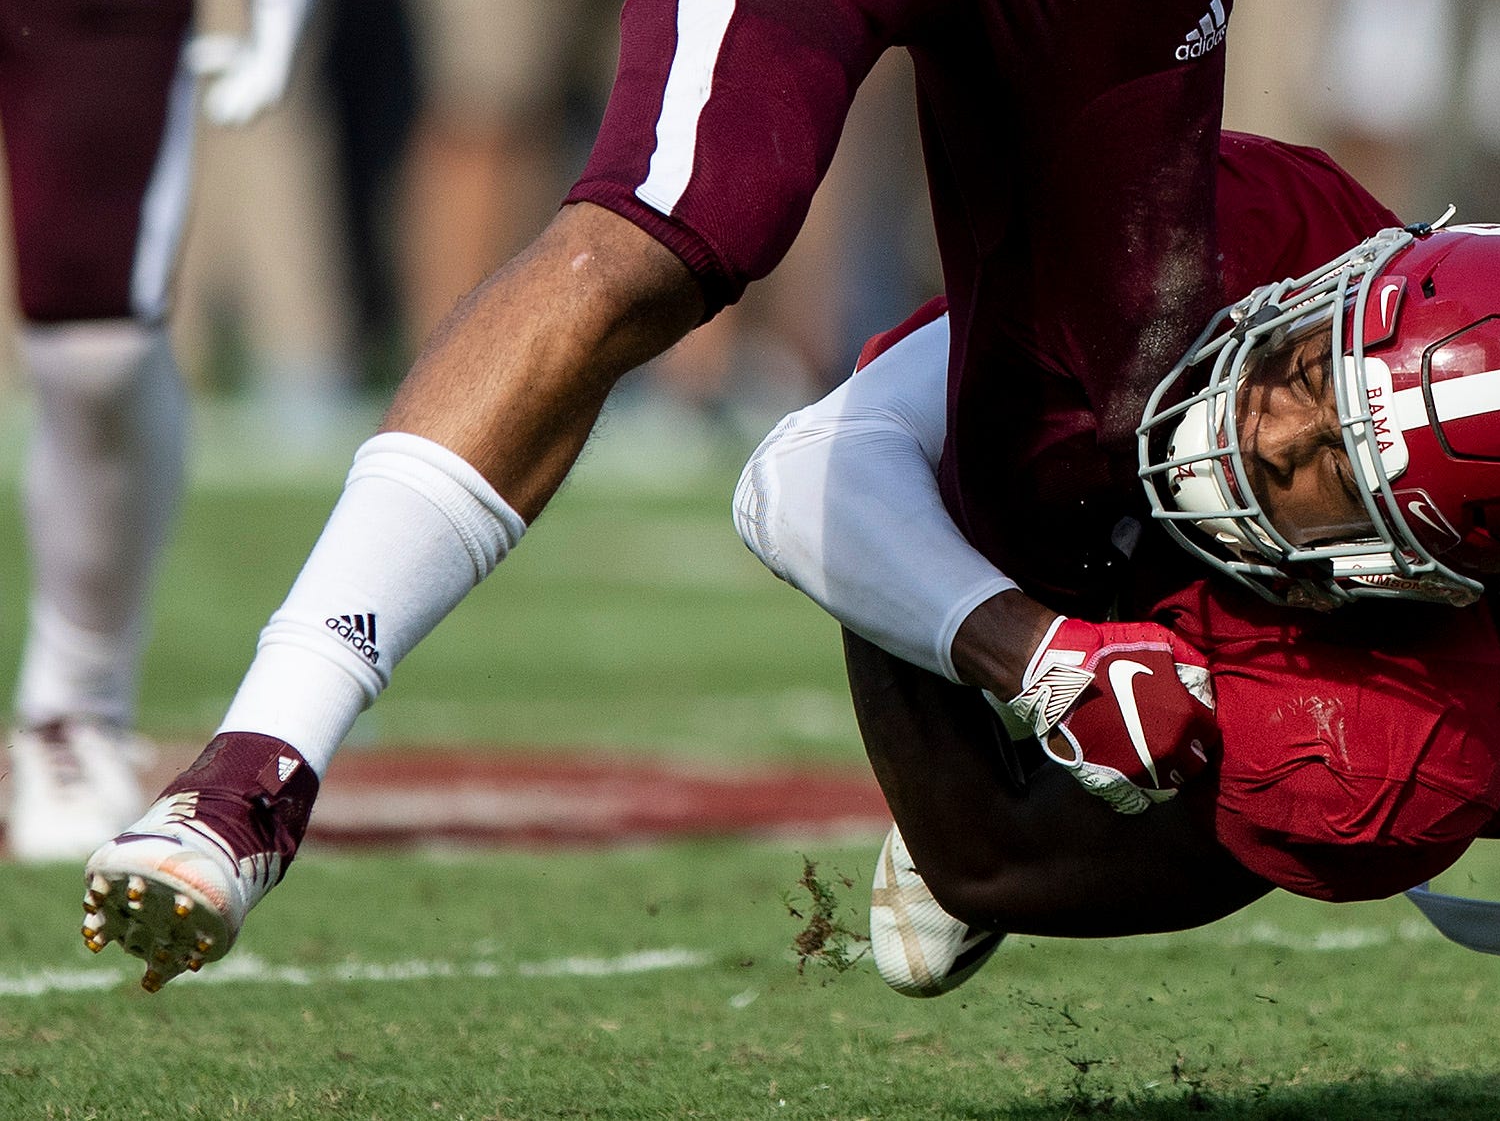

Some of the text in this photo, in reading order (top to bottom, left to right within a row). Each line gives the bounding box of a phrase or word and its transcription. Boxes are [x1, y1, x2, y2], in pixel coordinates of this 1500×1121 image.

[1174, 23, 1227, 61] adidas
[1365, 386, 1395, 454] BAMA
[325, 617, 380, 665] adidas
